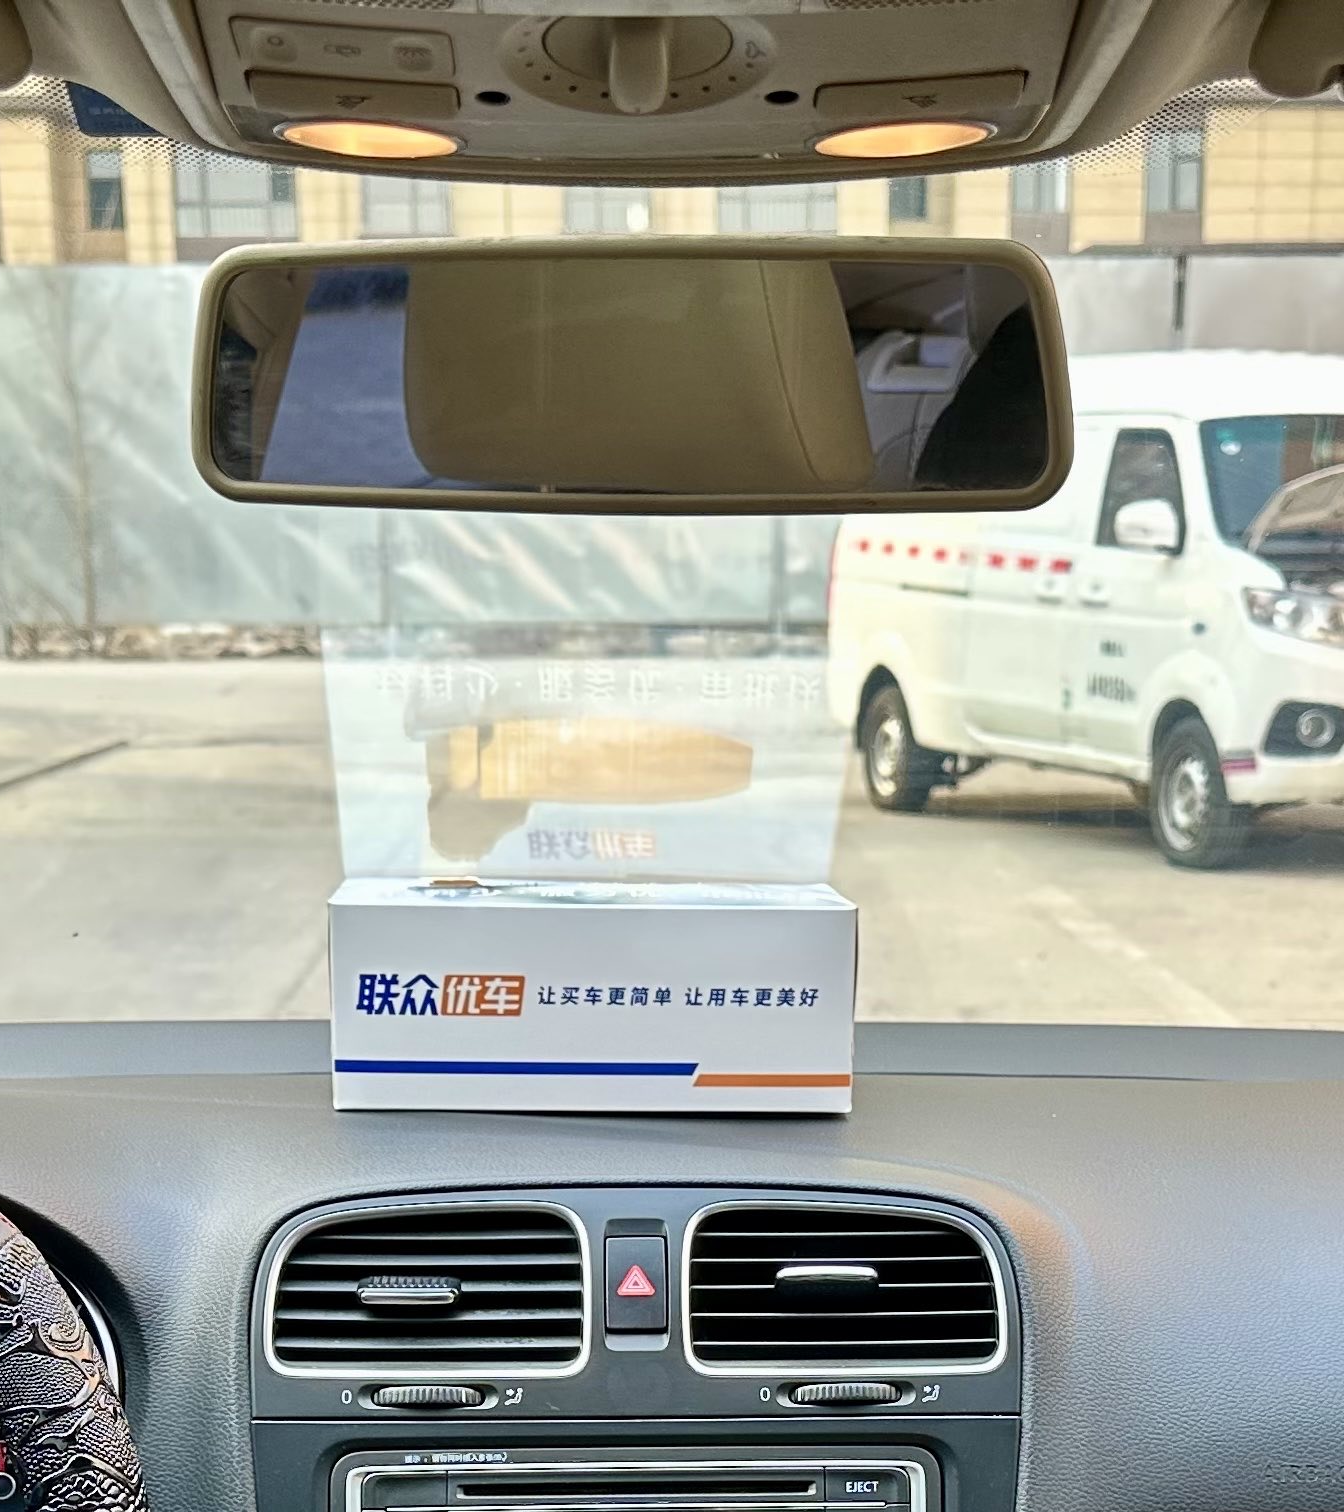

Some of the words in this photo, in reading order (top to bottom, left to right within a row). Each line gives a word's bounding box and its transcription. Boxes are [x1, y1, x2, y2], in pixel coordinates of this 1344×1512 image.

[356, 974, 522, 1016] 联众优车
[537, 986, 672, 1006] 让买车更简单
[684, 986, 819, 1007] 让用车更美好
[846, 1481, 879, 1493] EJECT
